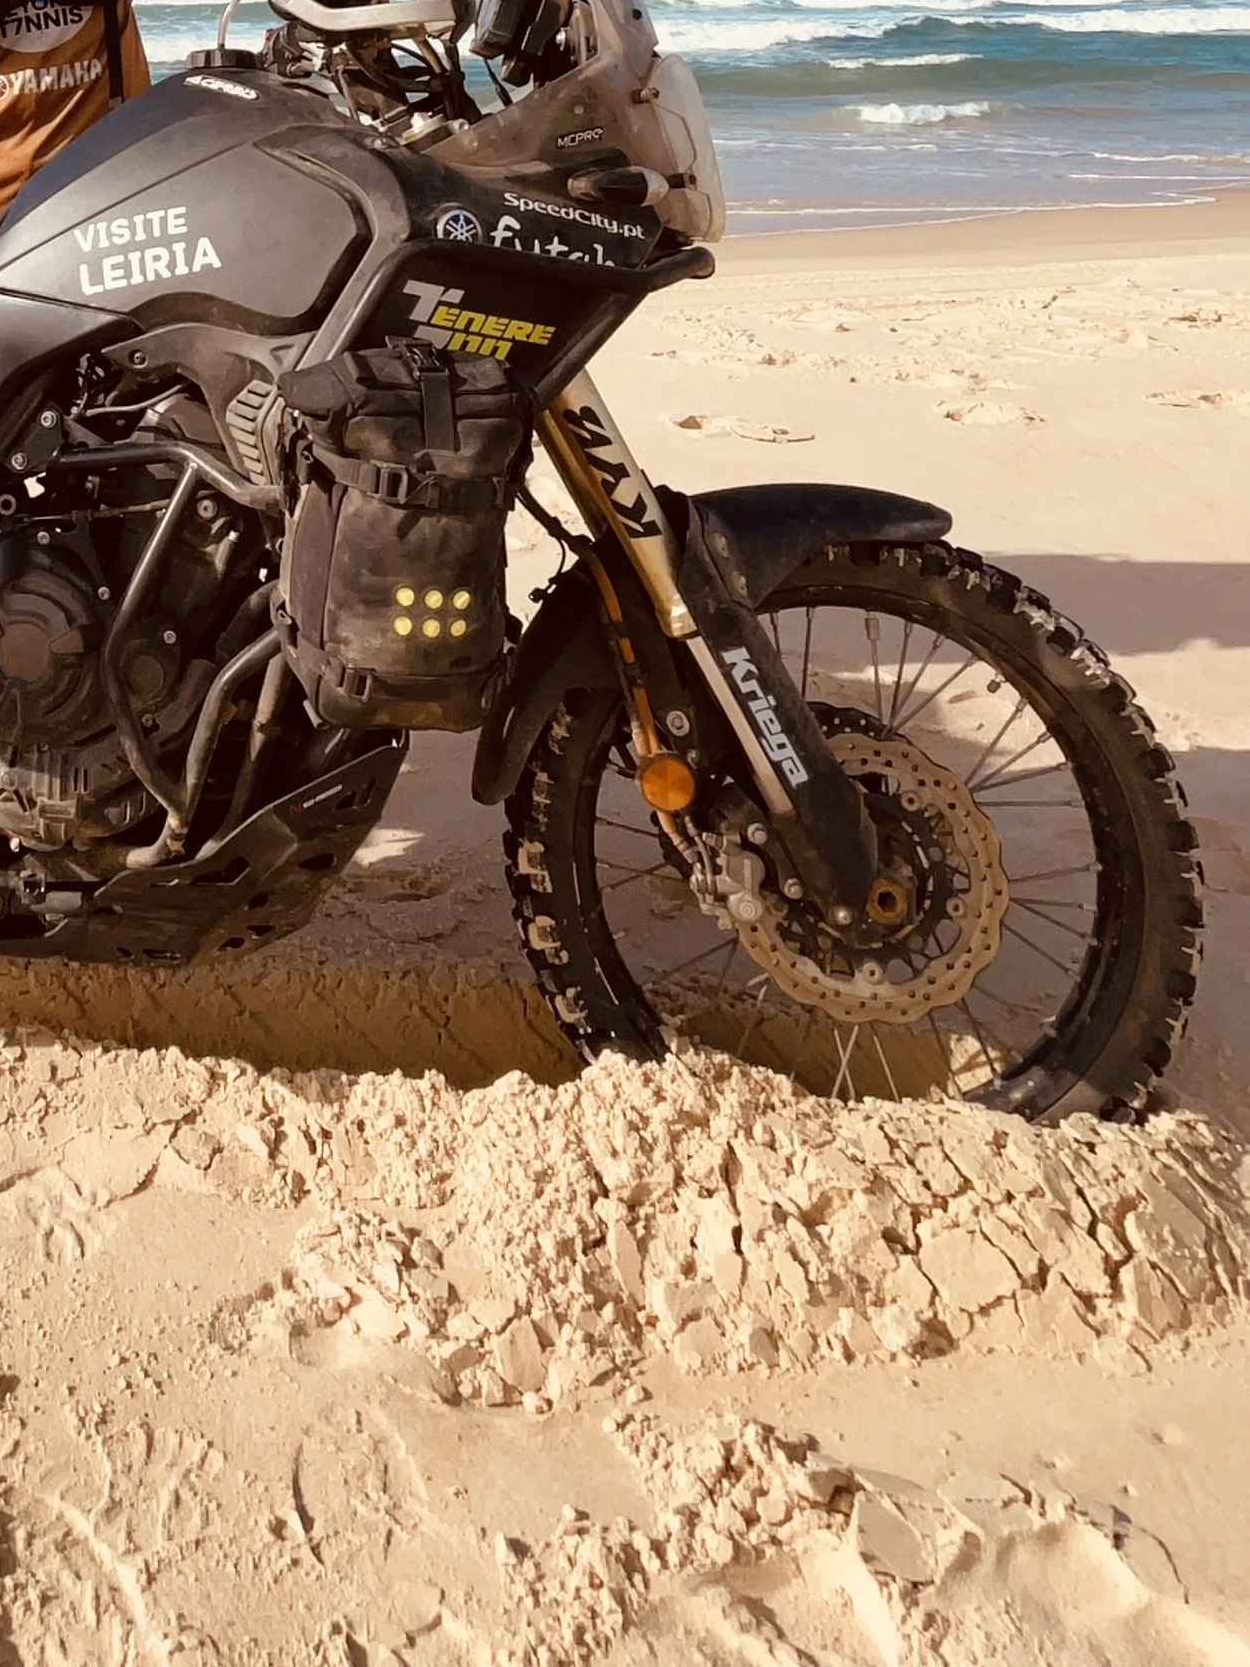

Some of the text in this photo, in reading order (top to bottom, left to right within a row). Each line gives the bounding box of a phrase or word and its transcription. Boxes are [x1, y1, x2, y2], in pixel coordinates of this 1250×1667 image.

[10, 58, 103, 95] YAMAHA
[73, 206, 188, 252] VISITE
[78, 237, 222, 295] LEIRIA
[721, 645, 809, 790] Kriega
